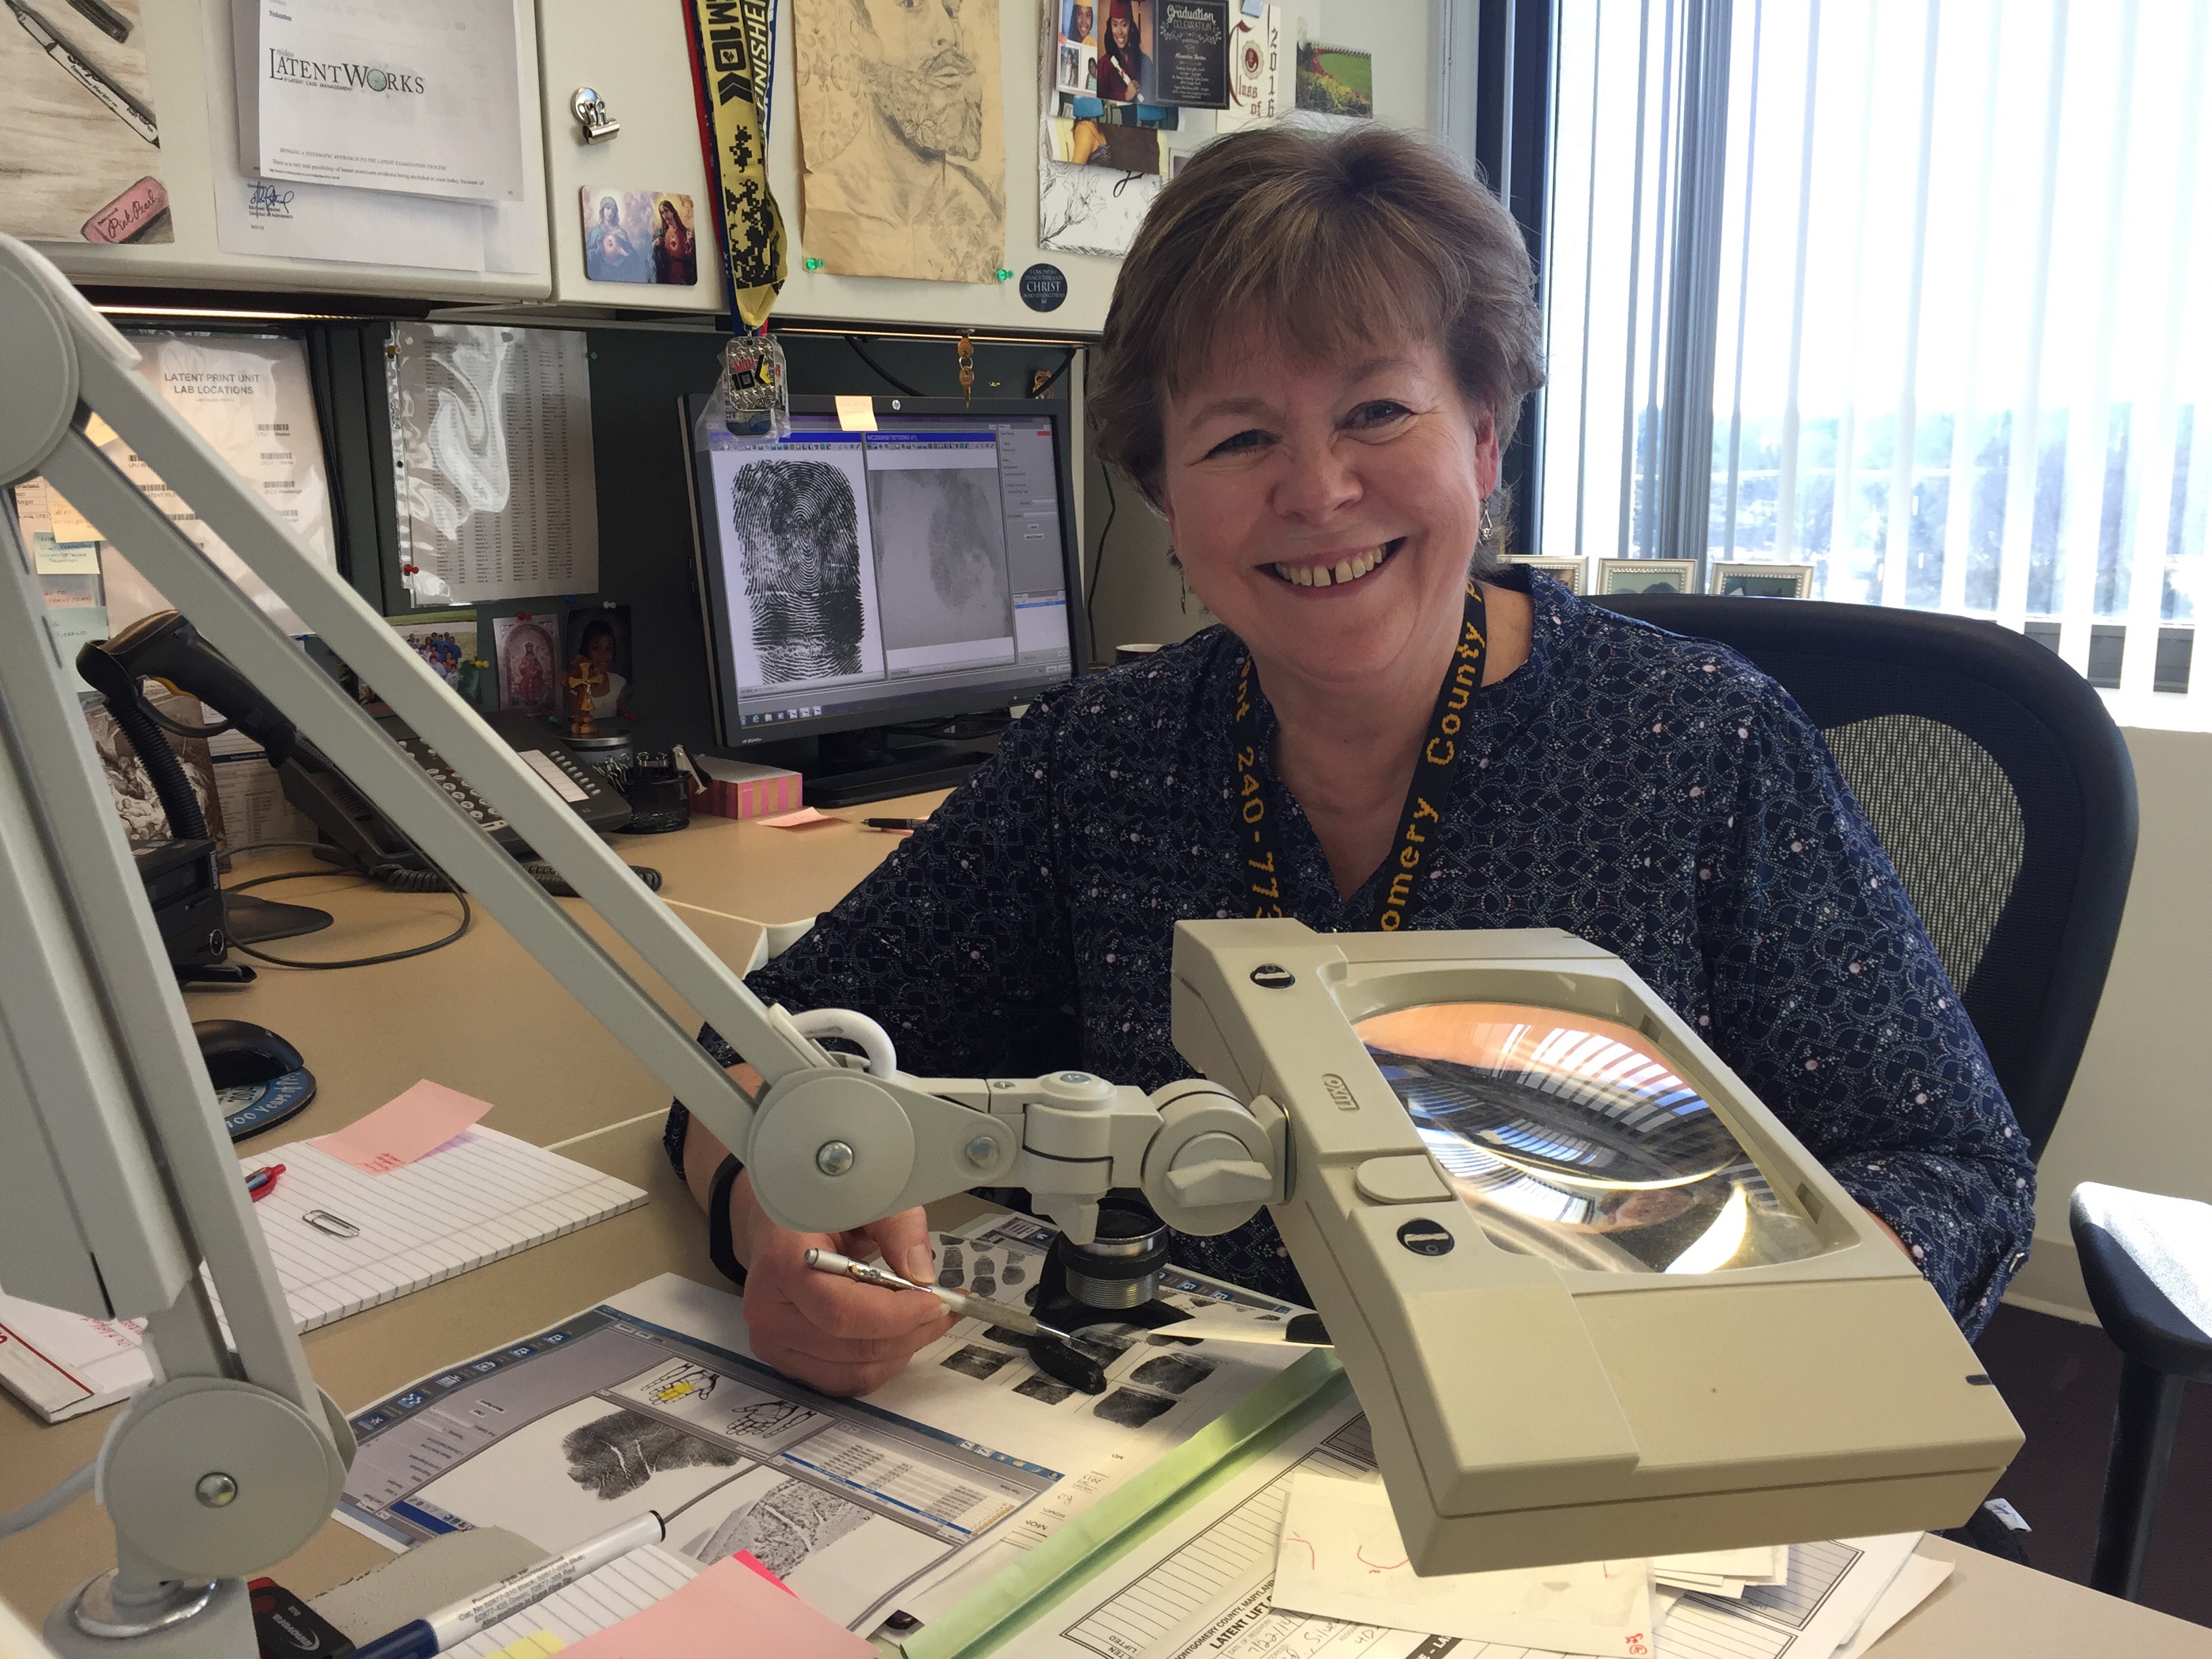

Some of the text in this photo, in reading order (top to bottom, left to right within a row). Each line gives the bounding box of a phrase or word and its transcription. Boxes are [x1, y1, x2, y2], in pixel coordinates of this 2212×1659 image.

[1167, 4, 1216, 25] Graduation
[1173, 19, 1212, 31] CELEBRATION
[744, 0, 767, 111] FINISHE
[1267, 27, 1278, 118] 2016
[1250, 102, 1262, 116] of
[108, 189, 157, 239] Pink Pearl
[1026, 281, 1061, 292] CHRIST
[164, 373, 260, 383] LATENT PRINT UNIT
[174, 386, 254, 394] LAB LOCATIONS
[1427, 620, 1486, 765] County
[254, 1094, 291, 1113] Years
[1218, 1605, 1245, 1629] COUNTY,
[1241, 1579, 1275, 1607] MARYLAND
[1747, 1599, 1767, 1611] Date
[1209, 1601, 1271, 1650] LATENT LIFT
[1108, 1647, 1126, 1659] TEN
[1109, 1635, 1137, 1654] LIFTED
[1227, 1644, 1242, 1656] DATE
[1241, 1638, 1248, 1646] OF
